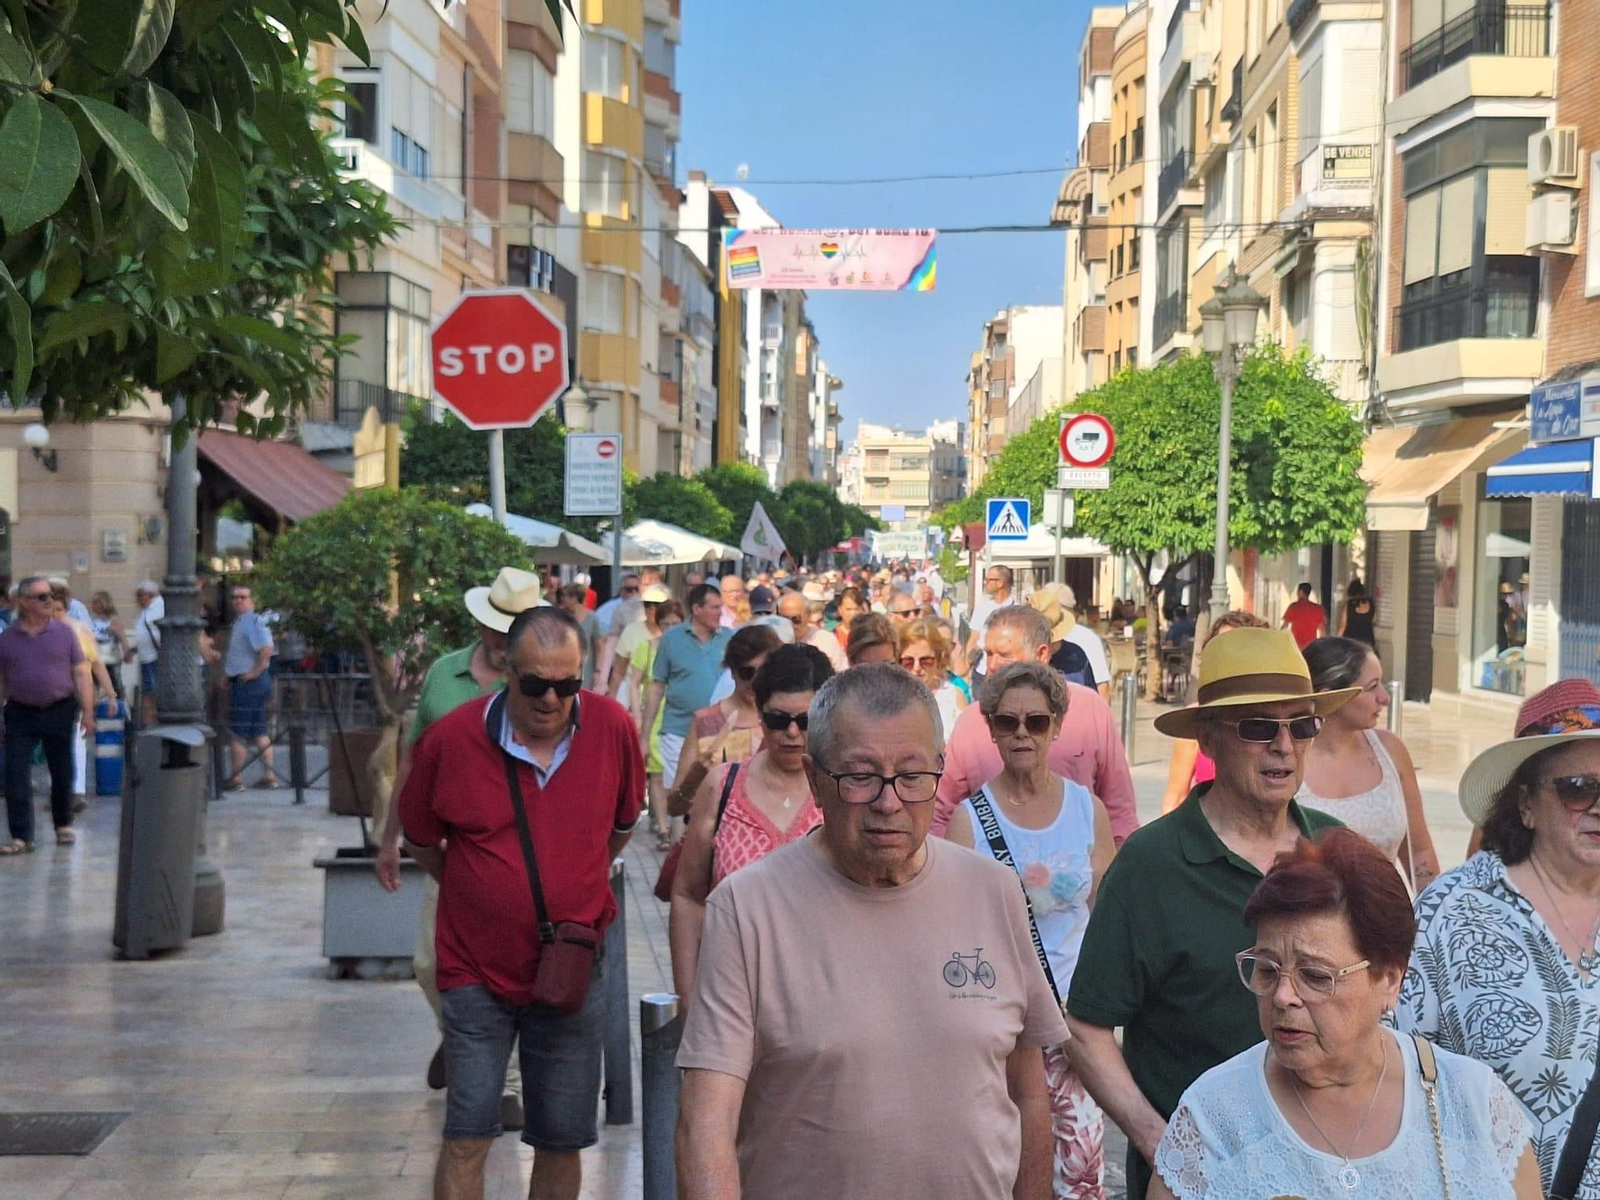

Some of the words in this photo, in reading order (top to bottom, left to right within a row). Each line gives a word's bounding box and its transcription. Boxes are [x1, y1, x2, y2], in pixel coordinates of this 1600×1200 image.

[1324, 147, 1337, 158] SE
[1338, 146, 1371, 158] VENDE
[440, 344, 554, 377] STOP
